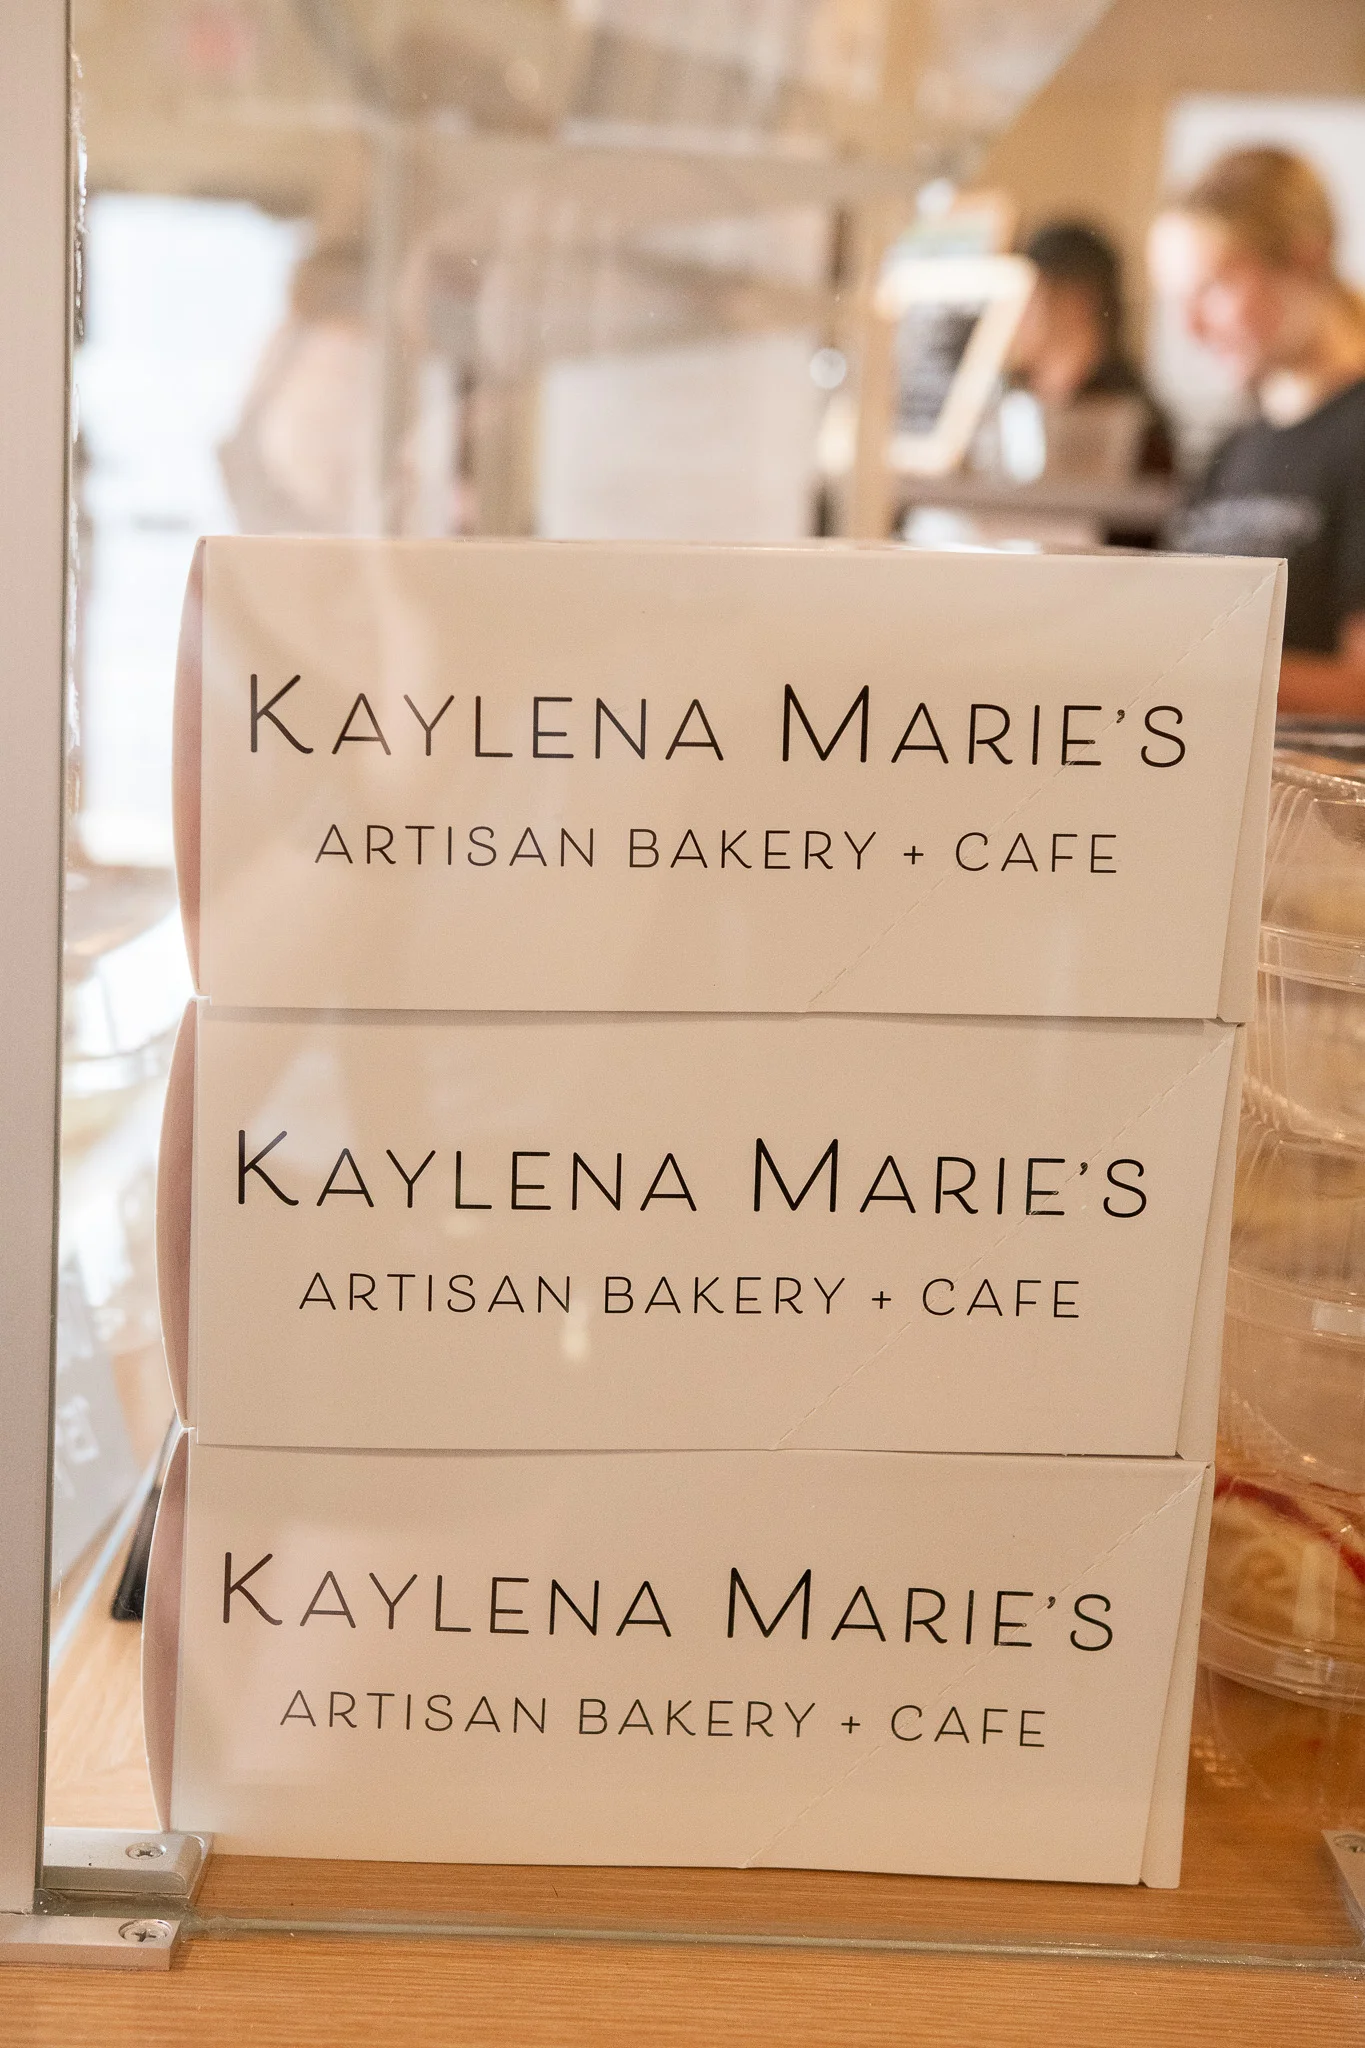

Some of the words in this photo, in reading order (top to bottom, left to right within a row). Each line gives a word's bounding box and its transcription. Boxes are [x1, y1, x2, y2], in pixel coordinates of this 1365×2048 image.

[250, 673, 725, 762] KAYLENA
[314, 823, 594, 868] ARTISAN
[629, 828, 877, 871] BAKERY
[903, 845, 925, 866] +
[954, 831, 1118, 874] CAFE
[237, 1129, 698, 1212] KAYLENA
[298, 1271, 571, 1314] ARTISAN
[604, 1275, 846, 1315] BAKERY
[871, 1290, 892, 1310] +
[922, 1277, 1081, 1319] CAFE
[222, 1551, 672, 1638] KAYLENA
[279, 1689, 546, 1734] ARTISAN
[578, 1698, 816, 1738] BAKERY
[840, 1715, 861, 1735] +
[890, 1704, 1046, 1748] CAFE
